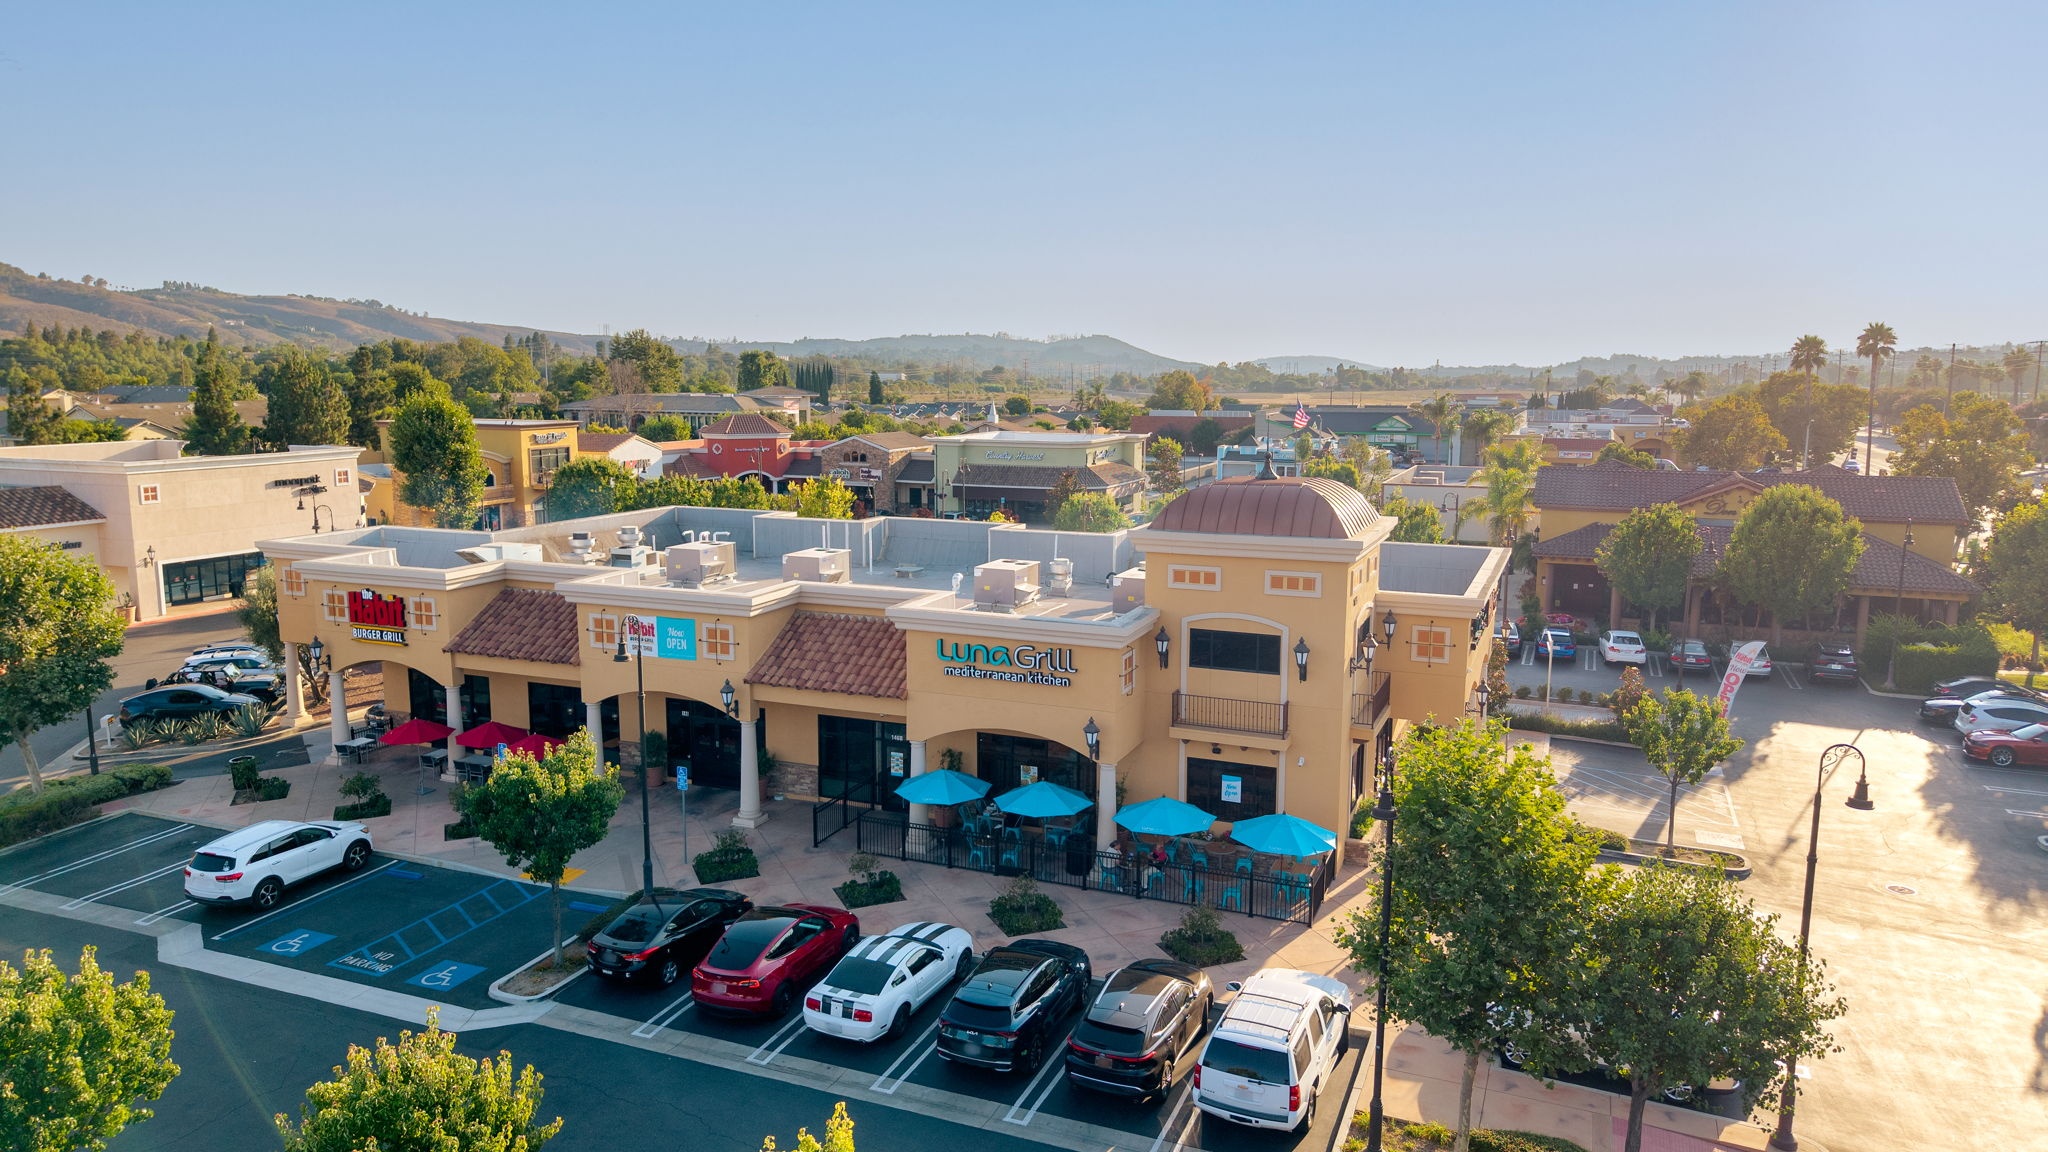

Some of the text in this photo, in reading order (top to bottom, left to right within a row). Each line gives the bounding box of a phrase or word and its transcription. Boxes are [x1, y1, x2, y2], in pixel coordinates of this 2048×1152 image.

[362, 588, 373, 600] the
[348, 591, 406, 628] Habit
[352, 628, 402, 642] BURGER GRILL
[667, 626, 685, 637] Now
[666, 638, 687, 650] OPEN
[937, 638, 1077, 673] Luna Grill
[1730, 664, 1747, 674] Now
[944, 665, 1070, 687] mediterranean kitchen
[372, 951, 394, 961] NO
[339, 955, 393, 972] PARKING
